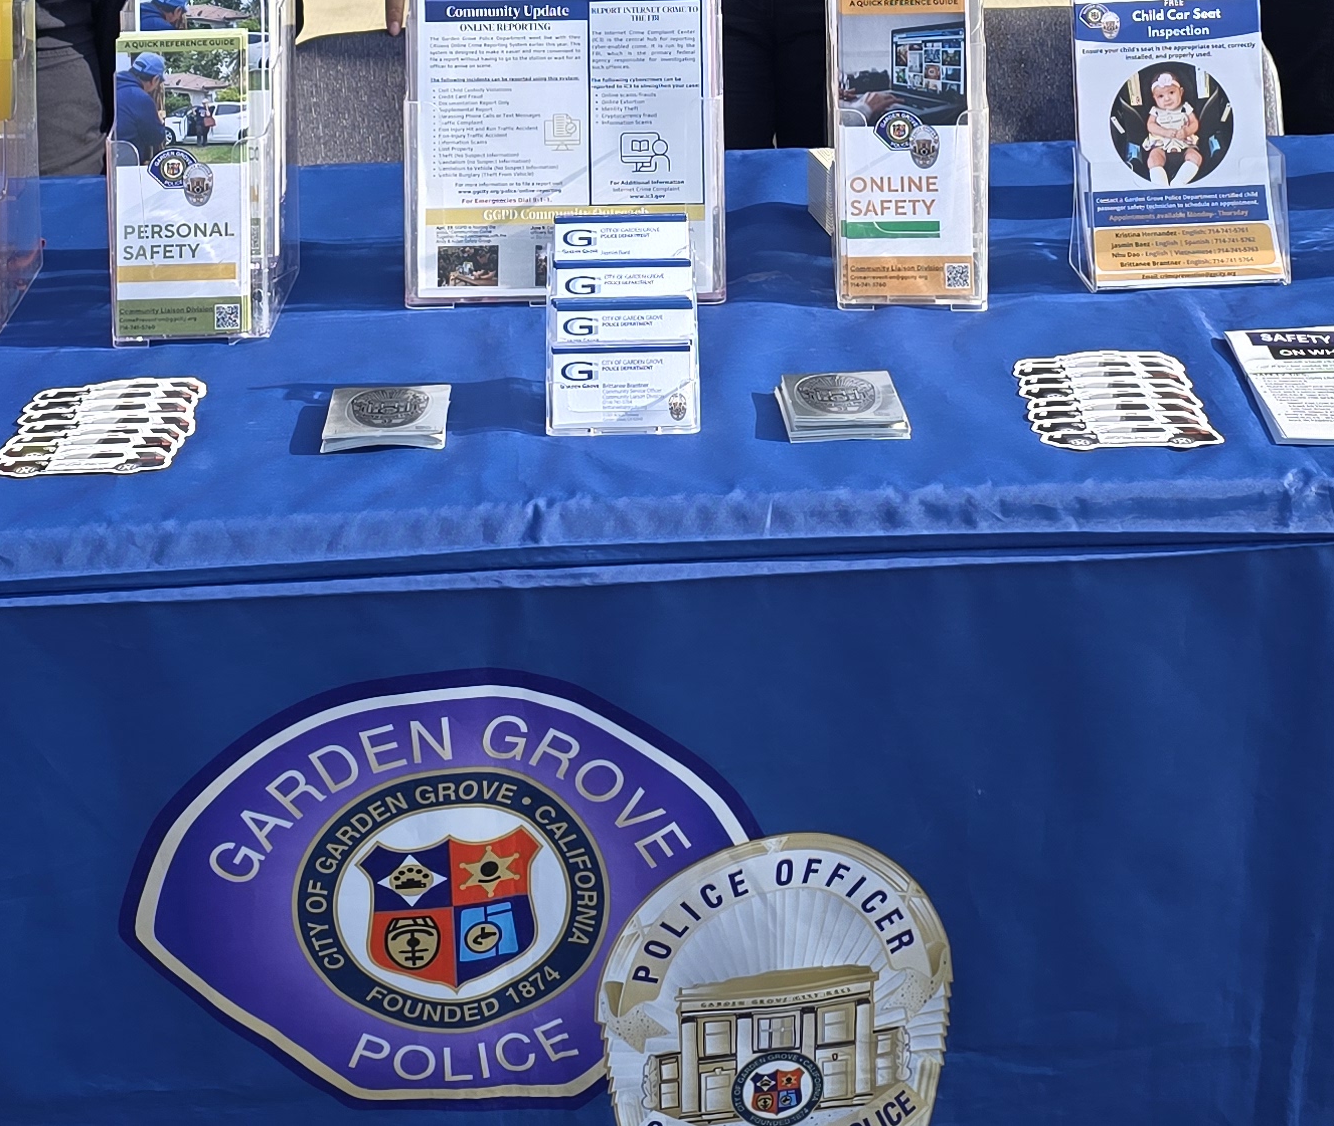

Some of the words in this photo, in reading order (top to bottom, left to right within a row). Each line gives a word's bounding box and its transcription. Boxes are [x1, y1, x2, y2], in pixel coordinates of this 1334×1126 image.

[446, 5, 521, 19] Community
[523, 5, 569, 19] Update
[1132, 9, 1165, 22] Child
[1167, 9, 1190, 20] Car
[1193, 8, 1222, 19] Seat
[460, 23, 495, 32] ONLINE
[497, 23, 551, 31] REPORTING
[1148, 24, 1210, 39] Inspection
[132, 41, 159, 49] QUICK
[154, 151, 175, 167] GARDEN
[176, 151, 193, 166] GROVE
[850, 176, 938, 193] ONLINE
[483, 209, 518, 221] GGPD
[850, 199, 936, 216] SAFETY
[123, 222, 235, 239] PERSONAL
[123, 243, 200, 260] SAFETY
[119, 307, 160, 315] Community
[1260, 333, 1331, 345] SAFETY
[208, 716, 453, 883] GARDEN
[482, 714, 692, 869] GROVE
[414, 780, 518, 805] GROVE
[315, 792, 408, 874] GARDEN
[534, 805, 598, 945] CALIFORNIA
[305, 879, 328, 913] OF
[631, 869, 750, 984] POLICE
[775, 858, 915, 955] OFFICER
[306, 921, 345, 970] CITY
[366, 985, 500, 1023] FOUNDED
[505, 965, 561, 1003] 1874
[700, 1000, 746, 1009] GARDEN
[751, 996, 789, 1006] GROVE
[348, 1017, 579, 1083] POLICE
[850, 1090, 916, 1126] ICE
